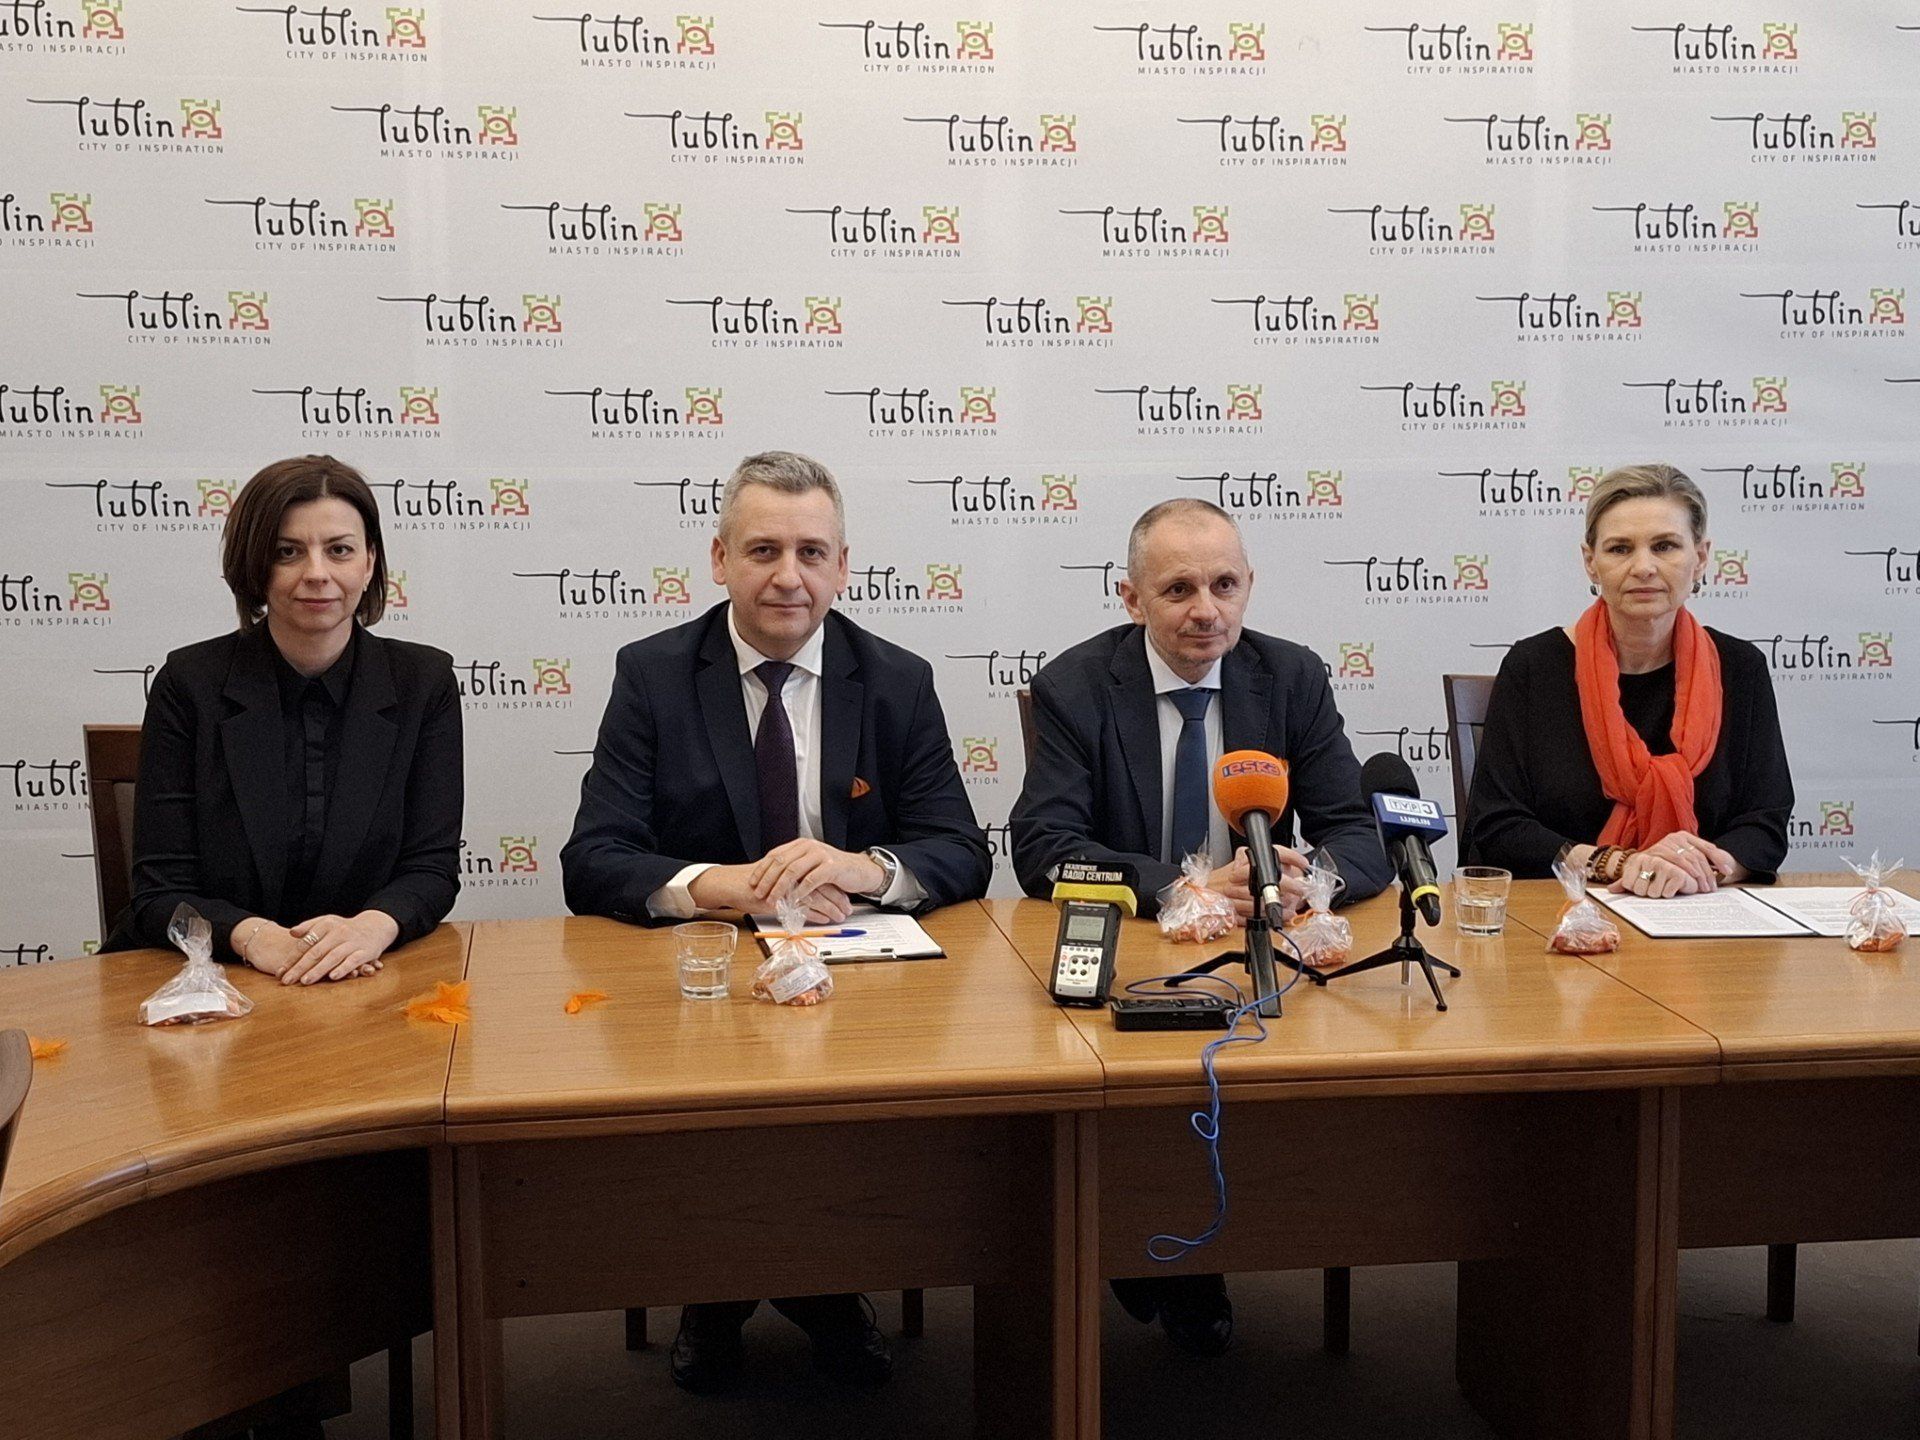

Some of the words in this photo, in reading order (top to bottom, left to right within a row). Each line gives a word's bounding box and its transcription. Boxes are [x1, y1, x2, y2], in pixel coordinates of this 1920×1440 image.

[42, 43, 126, 56] INSPIRACJI
[286, 50, 314, 60] CITY
[321, 51, 337, 60] OF
[344, 51, 428, 63] INSPIRATION
[580, 58, 632, 68] MIASTO
[640, 59, 716, 71] INSPIRACJI
[863, 63, 890, 73] CITY
[896, 64, 911, 73] OF
[917, 64, 995, 74] INSPIRATION
[1406, 65, 1432, 75] CITY
[1438, 65, 1452, 75] OF
[1458, 65, 1534, 75] INSPIRATION
[1672, 65, 1720, 74] MIASTO
[1727, 65, 1798, 75] INSPIRACJI
[1137, 66, 1186, 76] MIASTO
[1193, 66, 1266, 77] INSPIRACJI
[78, 142, 107, 152] CITY
[115, 143, 131, 152] OF
[138, 143, 224, 154] INSPIRATION
[380, 148, 433, 159] MIASTO
[440, 150, 519, 162] INSPIRACJI
[670, 153, 697, 163] CITY
[704, 154, 718, 164] OF
[725, 155, 804, 165] INSPIRATION
[1485, 156, 1533, 165] MIASTO
[1540, 155, 1612, 166] INSPIRACJI
[1750, 154, 1776, 164] CITY
[1782, 154, 1796, 163] OF
[1802, 153, 1877, 163] INSPIRATION
[947, 157, 997, 167] MIASTO
[1004, 157, 1078, 168] INSPIRACJI
[1219, 157, 1245, 167] CITY
[1251, 157, 1266, 167] OF
[1271, 157, 1347, 166] INSPIRATION
[11, 237, 95, 249] INSPIRACJI
[254, 241, 283, 251] CITY
[290, 242, 306, 251] OF
[313, 242, 396, 253] INSPIRATION
[1634, 244, 1681, 253] MIASTO
[1688, 243, 1759, 253] INSPIRACJI
[548, 245, 600, 256] MIASTO
[607, 246, 684, 258] INSPIRACJI
[830, 248, 856, 258] CITY
[863, 248, 877, 258] OF
[883, 248, 961, 258] INSPIRATION
[1102, 248, 1151, 258] MIASTO
[1157, 248, 1230, 259] INSPIRACJI
[1369, 246, 1395, 256] CITY
[1401, 246, 1414, 256] OF
[1421, 245, 1495, 255] INSPIRATION
[127, 334, 156, 344] CITY
[163, 335, 179, 344] OF
[186, 335, 271, 345] INSPIRATION
[1517, 333, 1564, 343] MIASTO
[1571, 332, 1642, 342] INSPIRACJI
[1780, 330, 1805, 340] CITY
[1811, 330, 1825, 339] OF
[1831, 329, 1905, 338] INSPIRATION
[426, 337, 478, 347] MIASTO
[485, 338, 563, 349] INSPIRACJI
[711, 339, 738, 349] CITY
[744, 339, 759, 348] OF
[765, 339, 843, 349] INSPIRATION
[985, 339, 1034, 348] MIASTO
[1041, 338, 1114, 349] INSPIRACJI
[1253, 336, 1278, 346] CITY
[1284, 336, 1298, 345] OF
[1304, 335, 1380, 345] INSPIRATION
[1401, 422, 1427, 432] CITY
[1432, 422, 1446, 431] OF
[1452, 421, 1526, 431] INSPIRATION
[1663, 419, 1711, 428] MIASTO
[1717, 418, 1788, 428] INSPIRACJI
[61, 429, 143, 439] INSPIRACJI
[301, 429, 329, 439] CITY
[336, 429, 352, 439] OF
[358, 429, 441, 439] INSPIRATION
[591, 430, 642, 439] MIASTO
[649, 430, 724, 440] INSPIRACJI
[868, 429, 894, 438] CITY
[900, 429, 915, 438] OF
[921, 428, 997, 438] INSPIRATION
[1137, 426, 1185, 436] MIASTO
[1192, 425, 1263, 435] INSPIRACJI
[1479, 508, 1526, 517] MIASTO
[1533, 507, 1586, 517] INSPIRA
[1740, 504, 1766, 513] CITY
[1771, 503, 1785, 512] OF
[1791, 502, 1865, 512] INSPIRATION
[951, 517, 999, 526] MIASTO
[1006, 515, 1078, 525] INSPIRACJI
[1249, 512, 1262, 521] OF
[1269, 511, 1343, 521] INSPIRATION
[96, 523, 125, 533] CITY
[132, 523, 147, 533] OF
[393, 521, 445, 531] MIASTO
[453, 521, 531, 532] INSPIRACJI
[679, 520, 705, 529] CITY
[1884, 586, 1909, 596] CITY
[1364, 596, 1390, 606] CITY
[1395, 596, 1409, 605] OF
[1415, 595, 1489, 604] INSPIRATION
[559, 610, 609, 619] MIASTO
[617, 609, 692, 619] INSPIRACJI
[867, 606, 881, 615] OF
[888, 605, 964, 615] INSPIRATION
[30, 616, 112, 627] INSPIRACJI
[1800, 673, 1813, 682] OF
[1820, 672, 1893, 681] INSPIRATION
[496, 700, 572, 710] INSPIRACJI
[14, 802, 69, 811] MIASTO
[1061, 870, 1085, 881] RADIO
[1085, 871, 1123, 882] CENTRUM
[463, 878, 539, 888] INSPIRACJI
